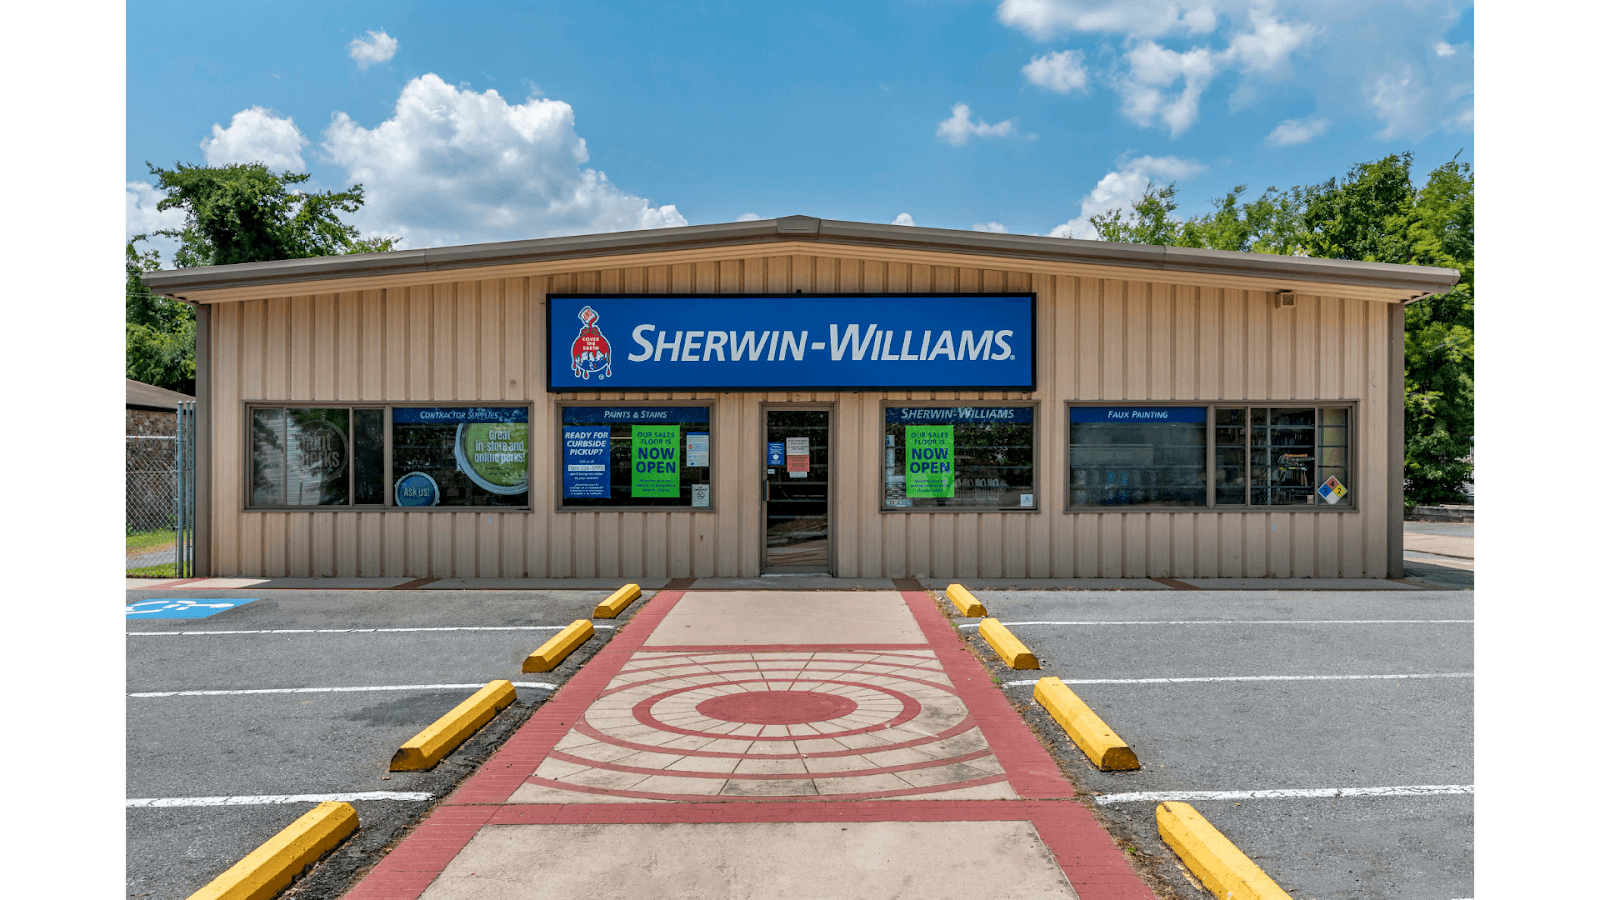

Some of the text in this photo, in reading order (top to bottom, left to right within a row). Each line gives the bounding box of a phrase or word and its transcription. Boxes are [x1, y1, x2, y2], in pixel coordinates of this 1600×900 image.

[627, 322, 1013, 362] SHERWIN-WILLIAMS
[420, 410, 498, 419] CONTRACTOR SUPPLIES
[604, 410, 667, 419] PAINTS & STAINS
[901, 408, 1015, 419] SHERWIN-WILLIAMS
[1132, 411, 1169, 419] PAINTING
[488, 429, 511, 440] Great
[508, 441, 524, 452] and
[569, 448, 604, 456] PICKUP?
[474, 452, 526, 465] online perks!
[638, 447, 675, 460] NOW
[911, 447, 949, 460] NOW
[636, 461, 676, 473] OPEN
[910, 461, 950, 474] OPEN
[403, 487, 430, 497] Ask us!
